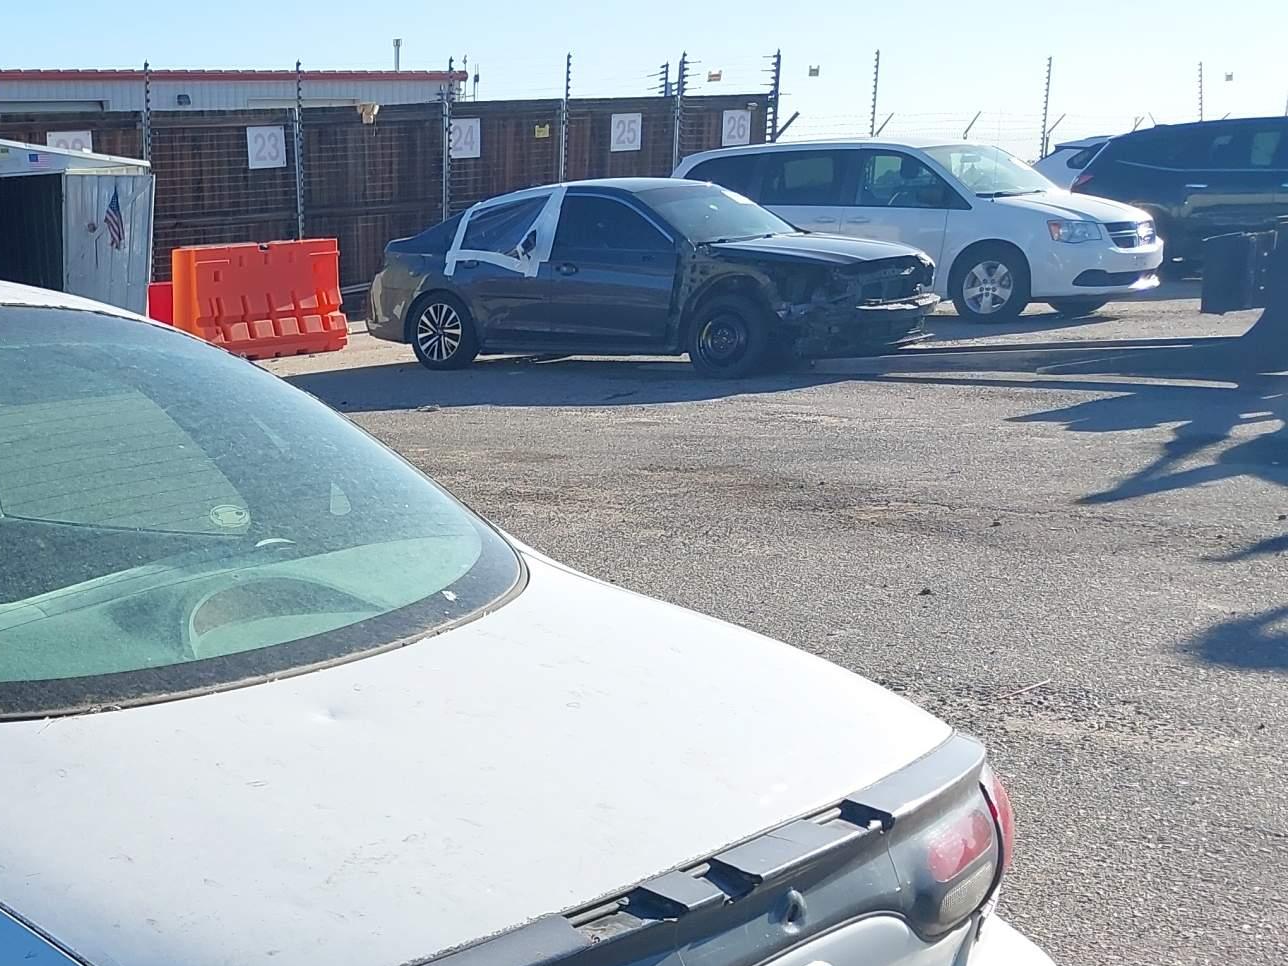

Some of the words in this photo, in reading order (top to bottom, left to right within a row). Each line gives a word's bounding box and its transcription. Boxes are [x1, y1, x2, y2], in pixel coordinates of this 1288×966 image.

[451, 125, 474, 151] 24
[615, 119, 637, 145] 25
[727, 115, 746, 140] 26
[254, 132, 280, 161] 23
